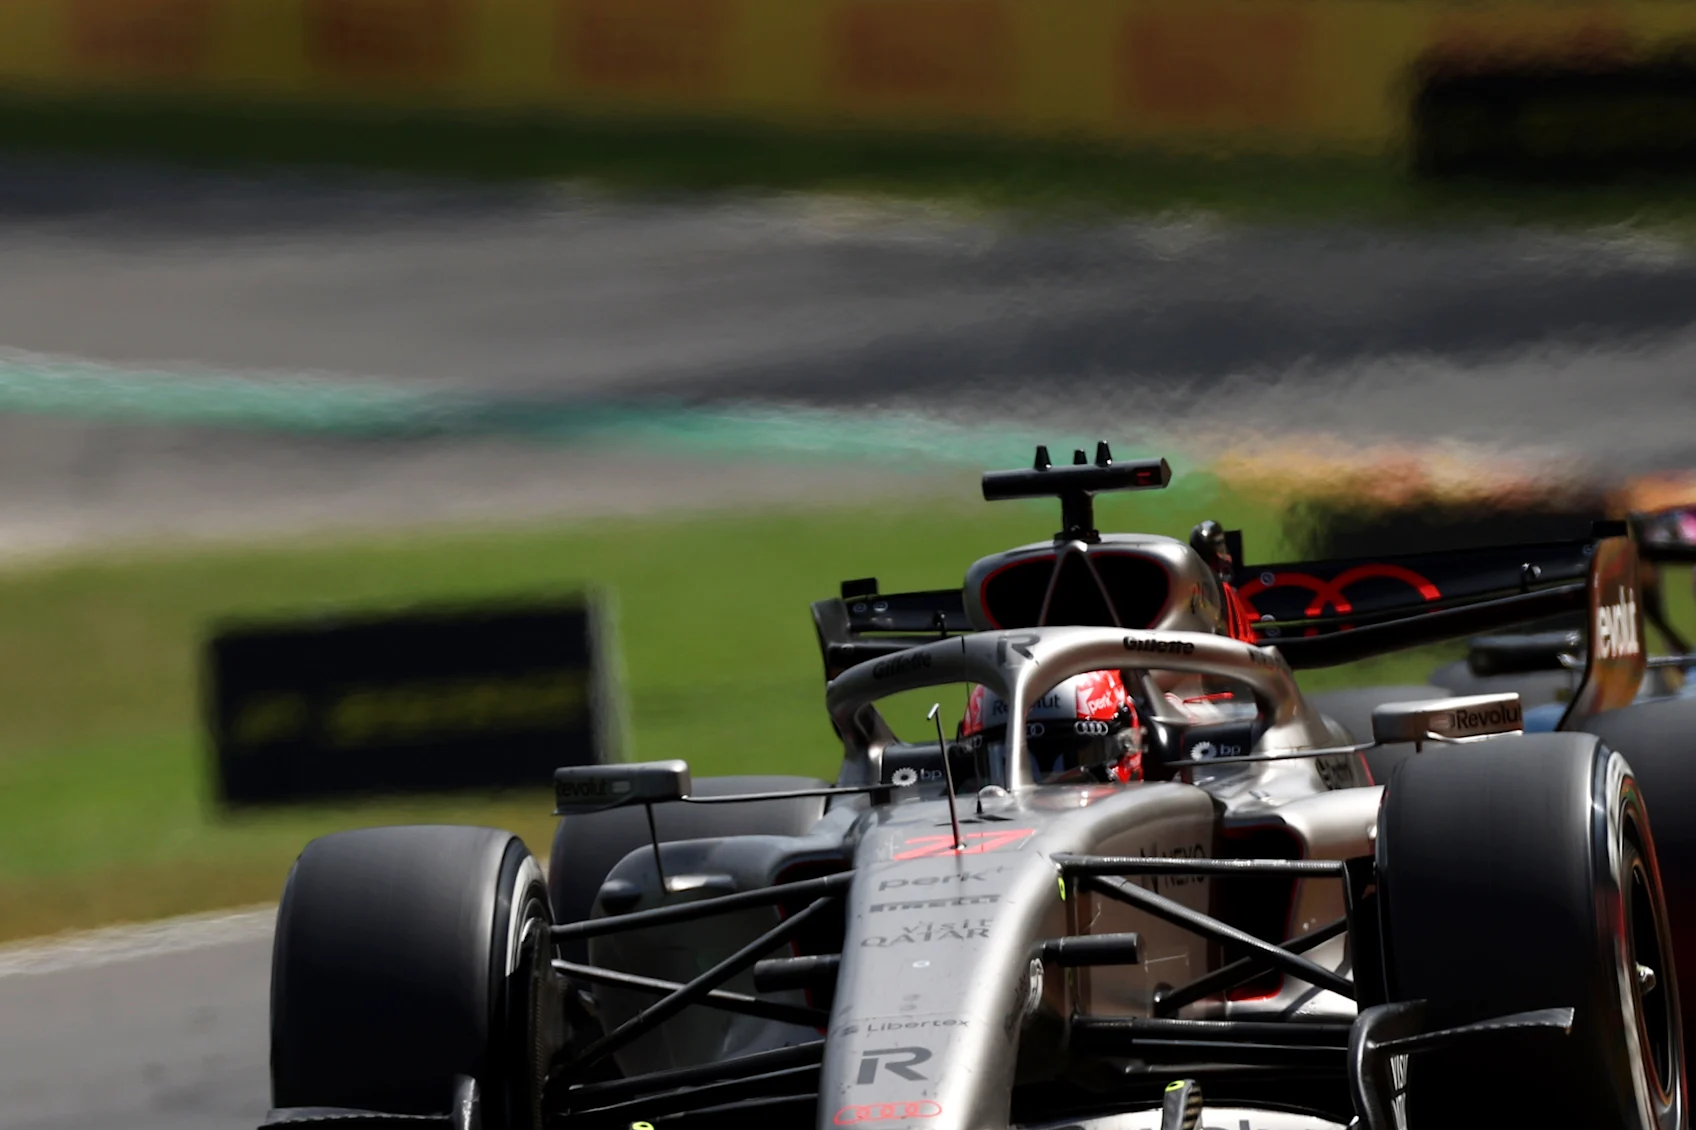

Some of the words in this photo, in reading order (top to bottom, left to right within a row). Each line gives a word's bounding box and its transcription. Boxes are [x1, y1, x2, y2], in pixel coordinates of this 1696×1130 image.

[1122, 635, 1195, 655] Gillette
[993, 695, 1060, 718] Relut
[1219, 744, 1241, 757] bp
[920, 769, 942, 781] bp
[893, 828, 1036, 861] 27
[867, 1017, 971, 1033] Libertex
[856, 1046, 933, 1085] R
